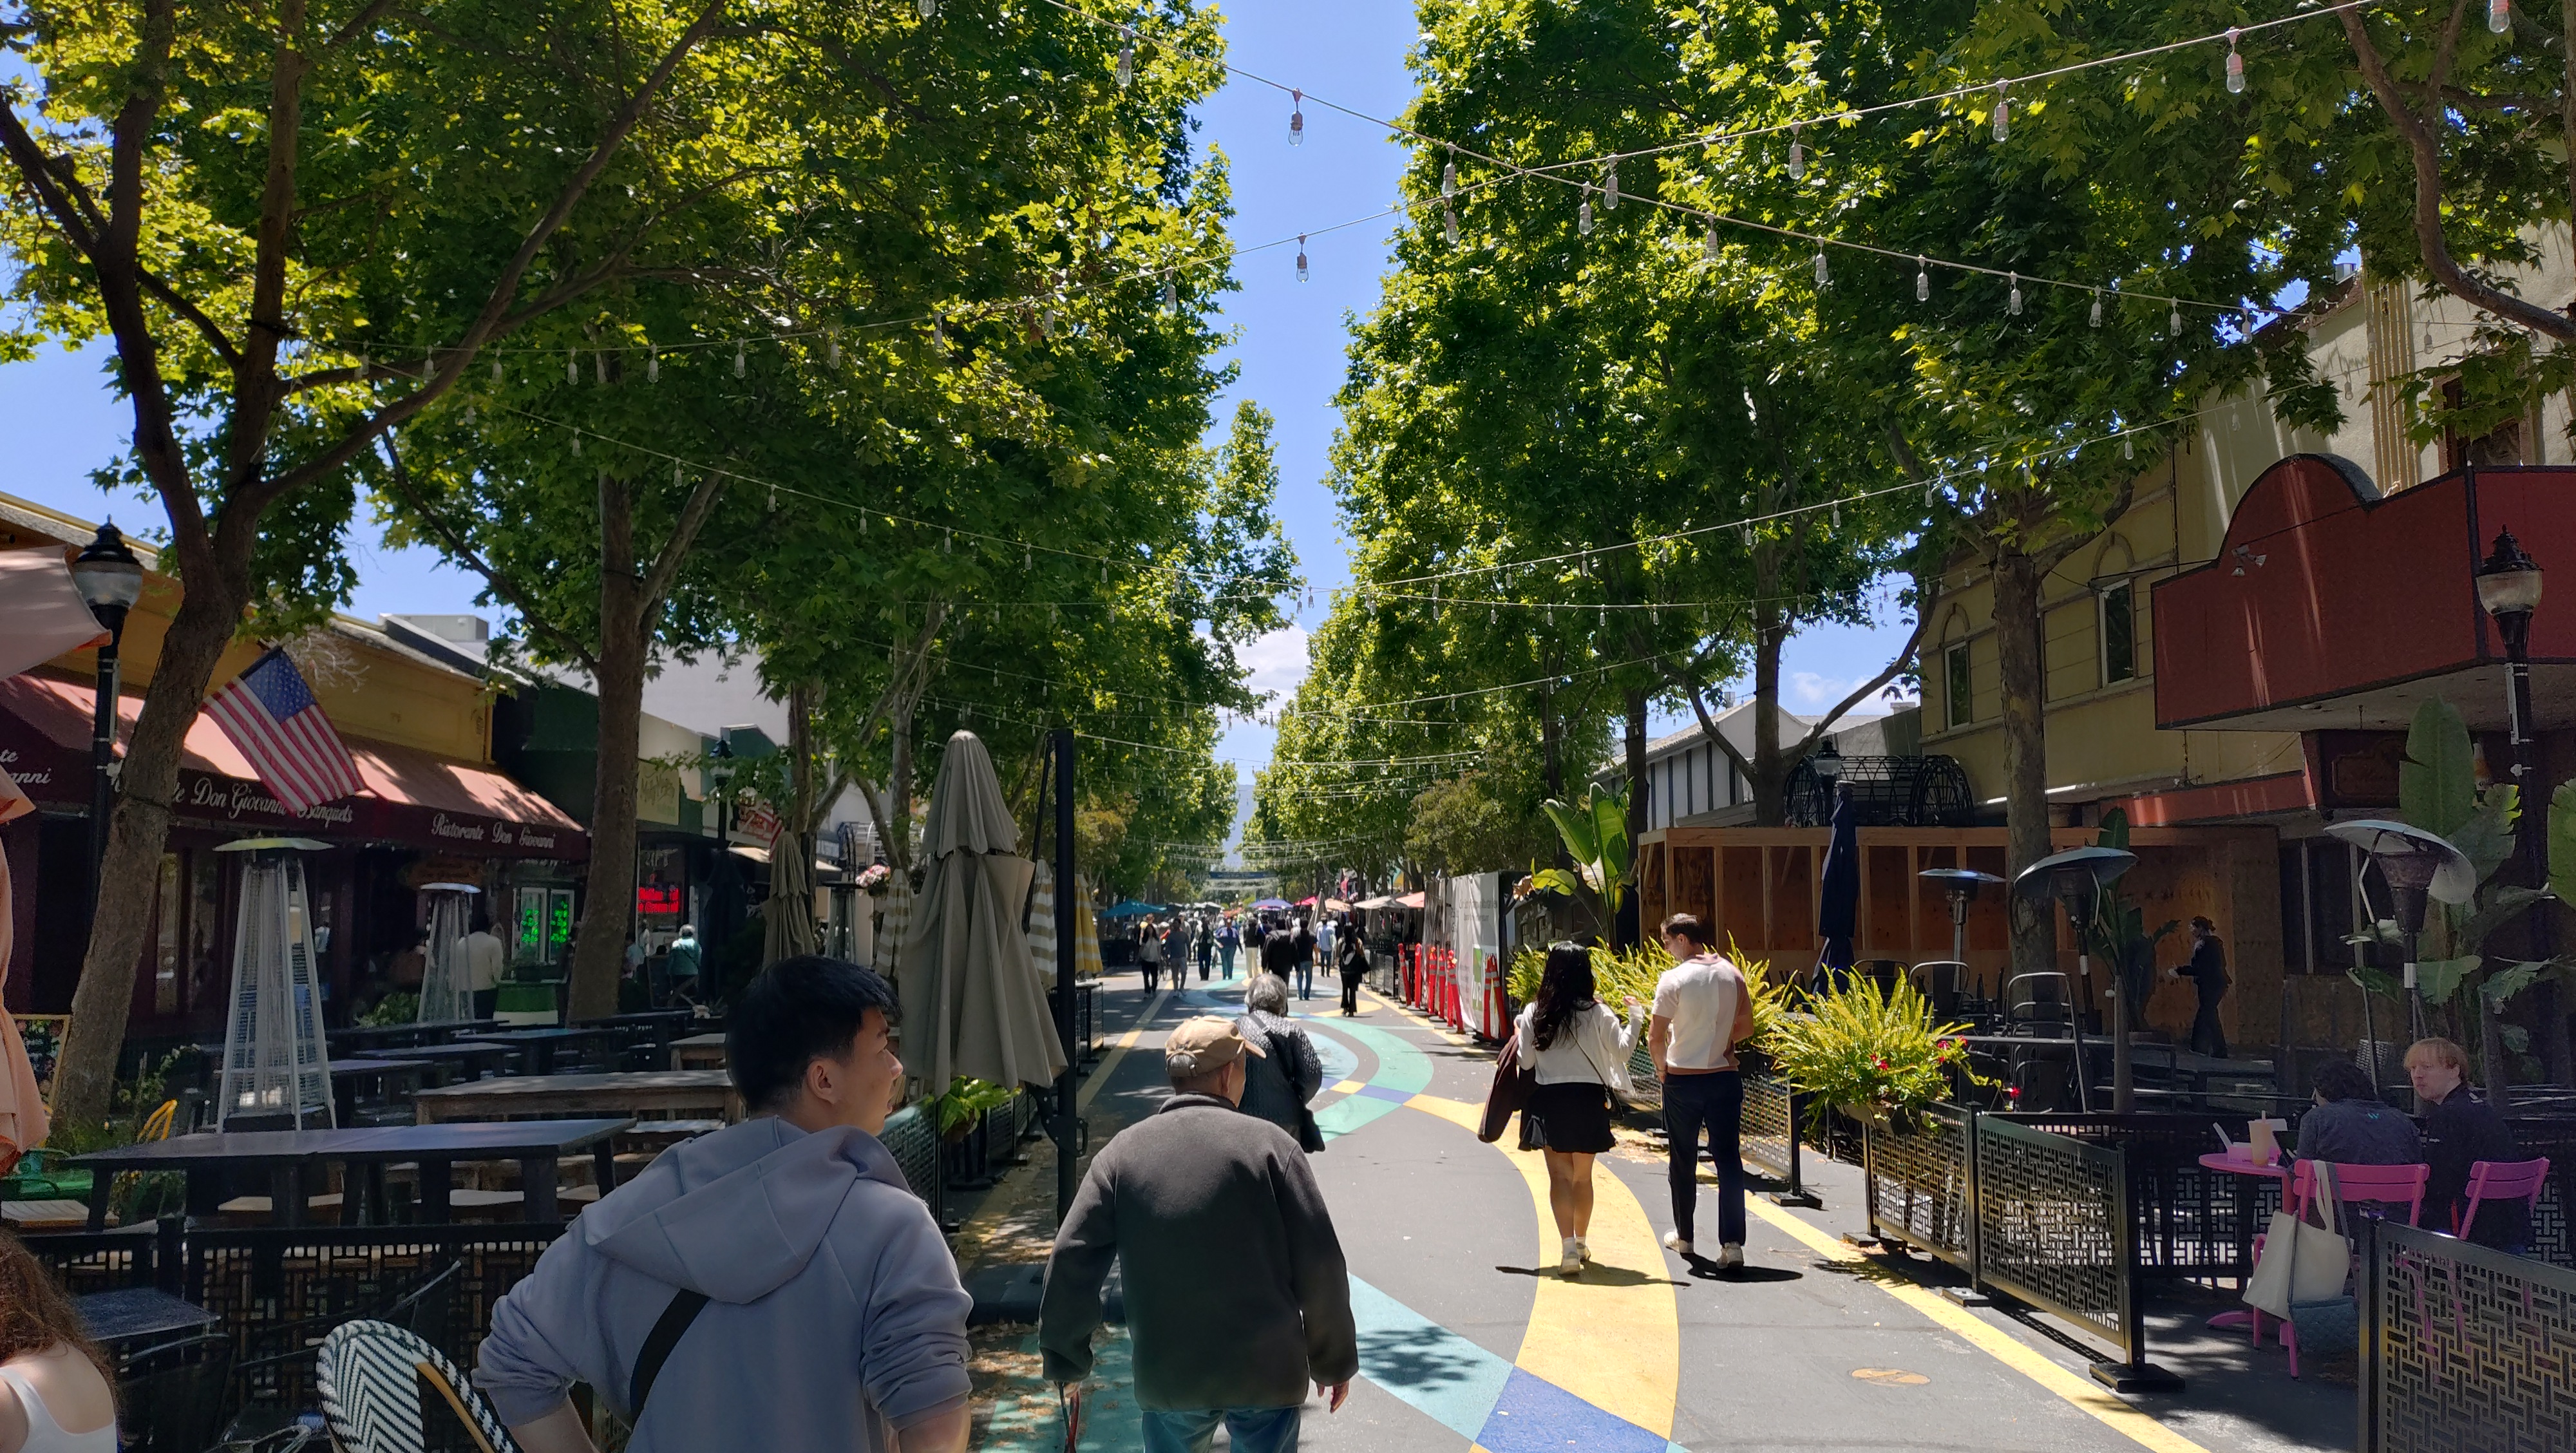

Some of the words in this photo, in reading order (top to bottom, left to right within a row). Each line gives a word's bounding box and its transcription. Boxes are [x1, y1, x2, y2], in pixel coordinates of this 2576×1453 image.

[191, 777, 227, 808] Don
[430, 813, 484, 841] Ristorante
[491, 821, 513, 844] Don
[518, 826, 556, 849] Giovanni
